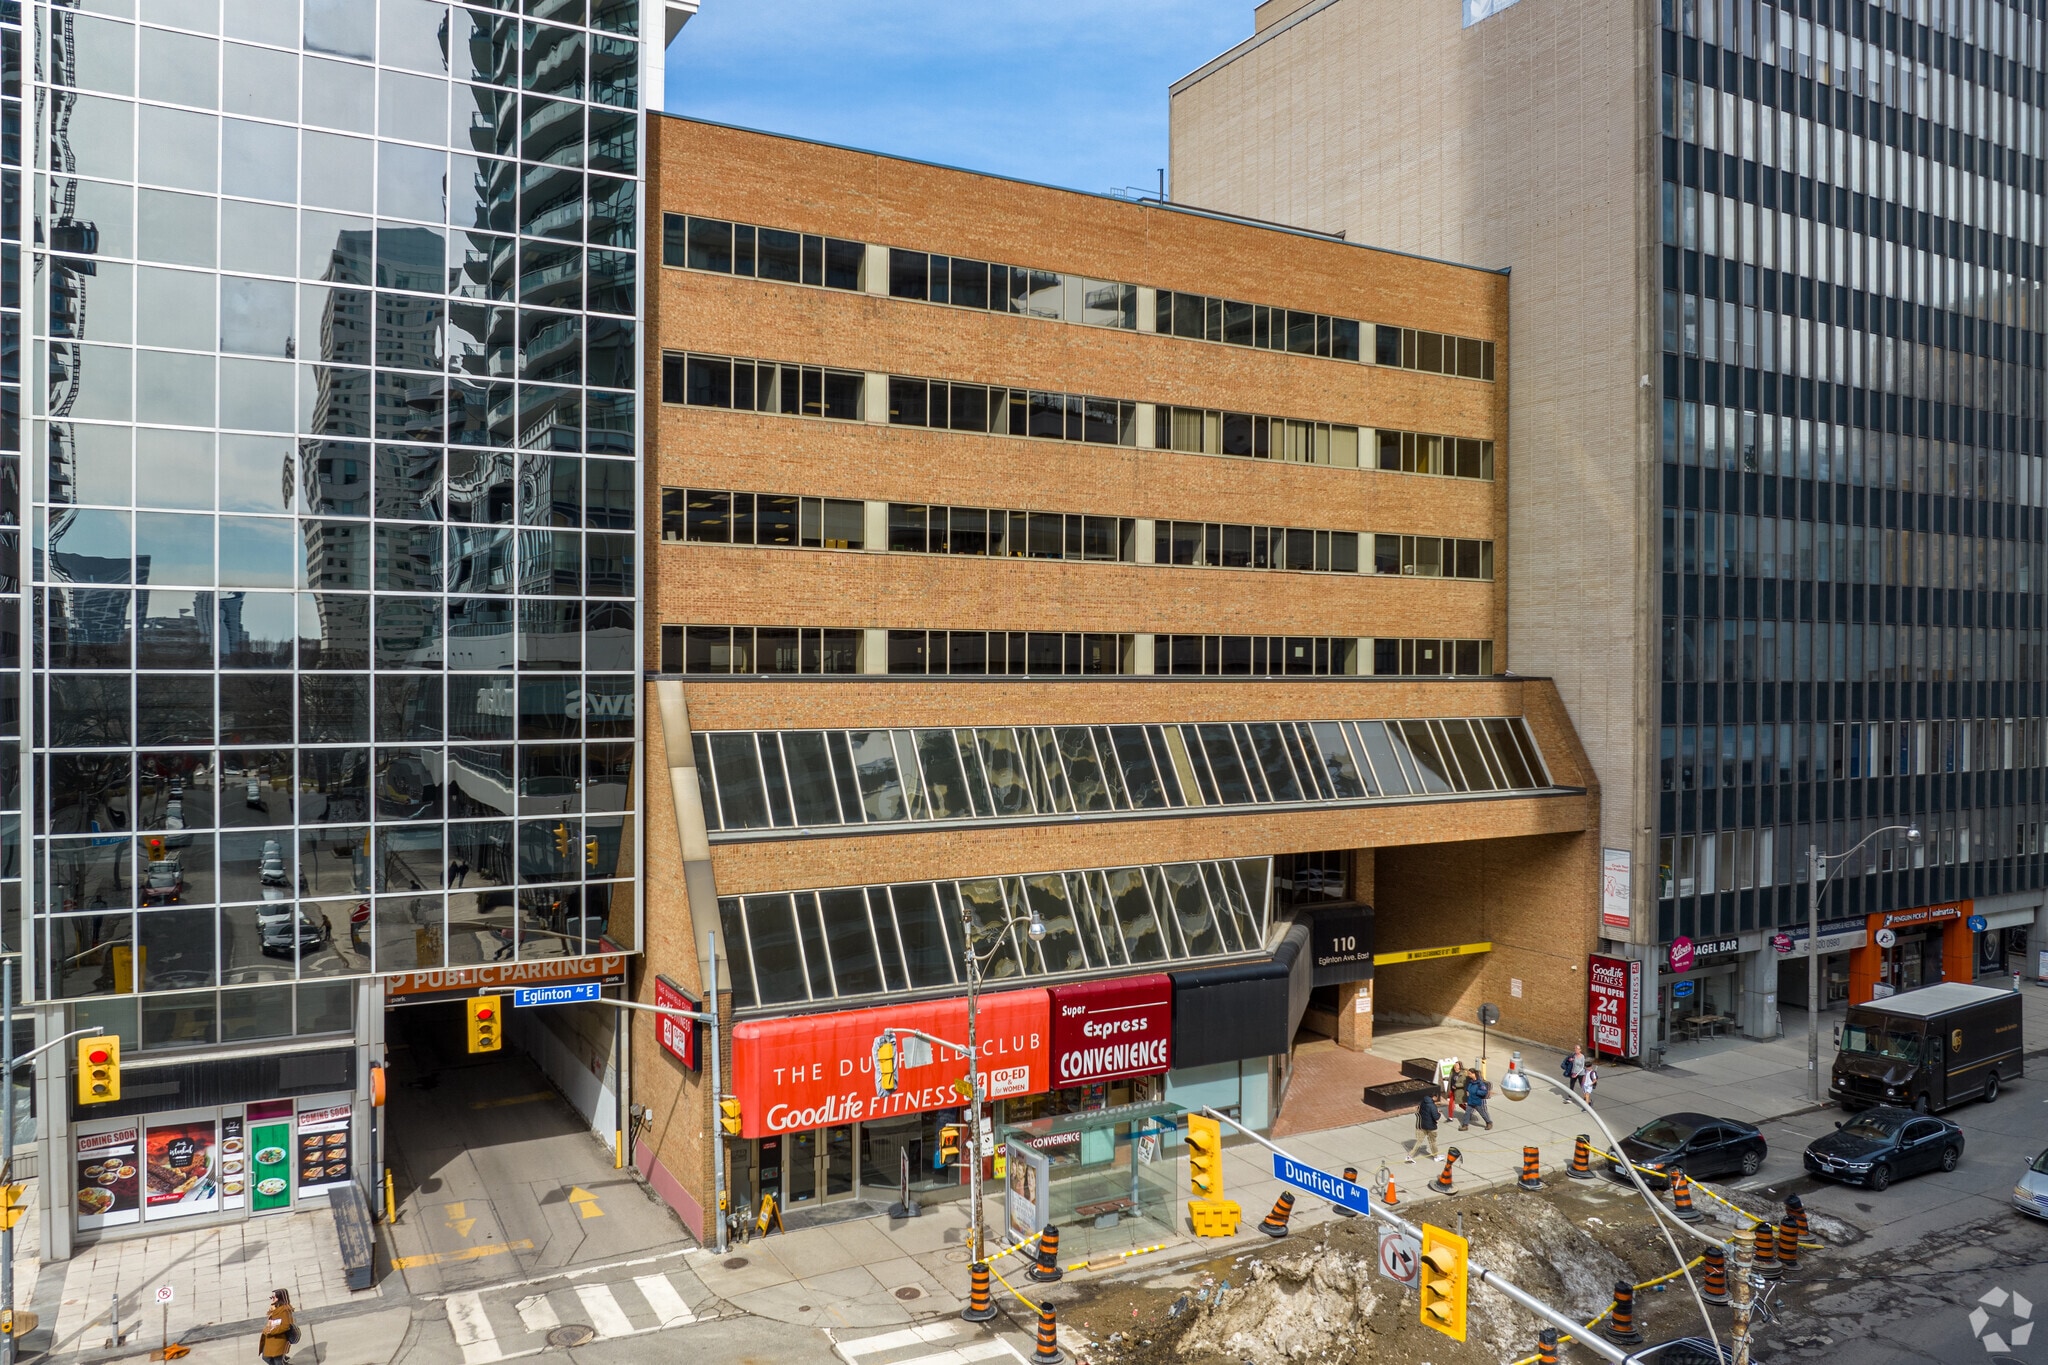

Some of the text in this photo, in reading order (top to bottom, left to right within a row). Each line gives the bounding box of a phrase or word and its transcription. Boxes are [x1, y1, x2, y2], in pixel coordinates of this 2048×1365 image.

[1333, 936, 1356, 952] 110
[1720, 940, 1737, 952] BAR
[1319, 952, 1370, 966] Eglinton Ave. East
[413, 966, 494, 990] PUBLIC
[500, 957, 596, 982] PARKING
[1592, 964, 1624, 978] GoodLife
[1593, 974, 1624, 987] FITNESS
[522, 989, 572, 1004] Eglinton
[586, 985, 594, 998] E
[1592, 984, 1624, 998] NOW OPEN
[1062, 1004, 1086, 1018] Super
[1597, 996, 1618, 1014] 24
[1083, 1017, 1148, 1040] Express
[1598, 1026, 1619, 1036] O-ED
[774, 1033, 1040, 1086] THE DUFLD CLUB
[1060, 1038, 1168, 1078] CONVENIENCE
[994, 1068, 1026, 1082] CO-ED
[1002, 1084, 1025, 1092] WOMEN
[300, 1106, 350, 1124] COMING SOON
[766, 1091, 864, 1132] GoodLife
[869, 1084, 958, 1116] FITNESS
[80, 1129, 135, 1150] COMING SOON
[1033, 1132, 1080, 1148] CONVENIENCE
[1284, 1160, 1361, 1200] Dunfield Av
